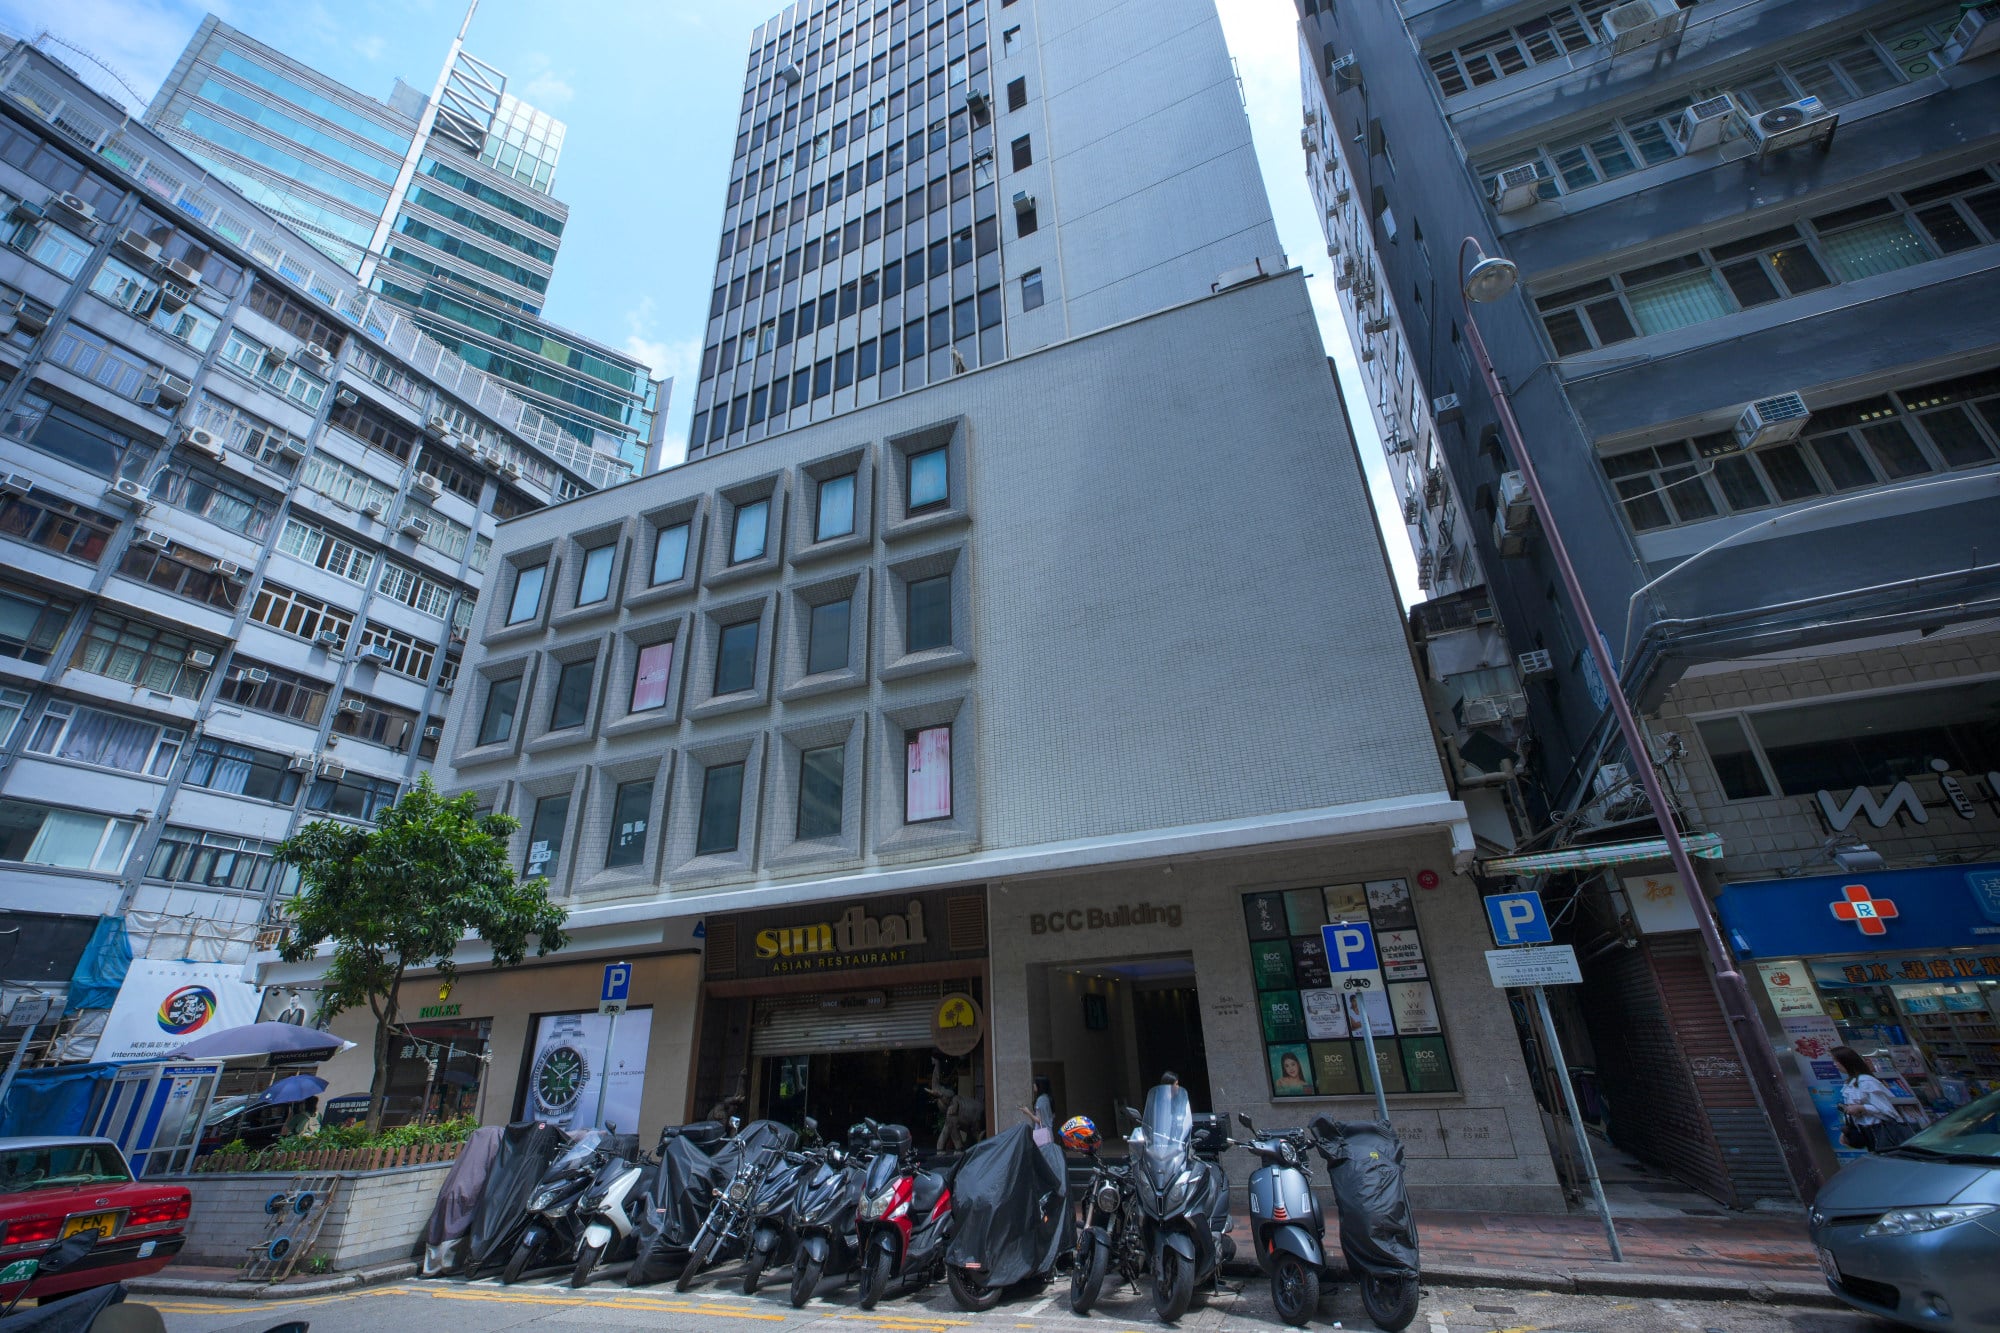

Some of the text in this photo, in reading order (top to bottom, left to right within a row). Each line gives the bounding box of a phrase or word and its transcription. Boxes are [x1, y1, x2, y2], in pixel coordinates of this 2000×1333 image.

[1030, 902, 1183, 935] BCC Building
[1499, 899, 1535, 940] P
[755, 899, 928, 960] sun thai
[1333, 929, 1365, 968] P
[1381, 943, 1418, 953] GAMING
[773, 950, 907, 972] ASIAN RESTAURANT
[1263, 952, 1281, 961] BCC
[608, 968, 627, 998] P
[419, 1004, 462, 1019] ROLEX
[1272, 1003, 1289, 1012] BCC
[111, 1051, 166, 1059] International
[1324, 1054, 1343, 1063] BCC
[1376, 1052, 1388, 1060] CC
[1415, 1050, 1435, 1060] BCC
[80, 1215, 104, 1229] FN
